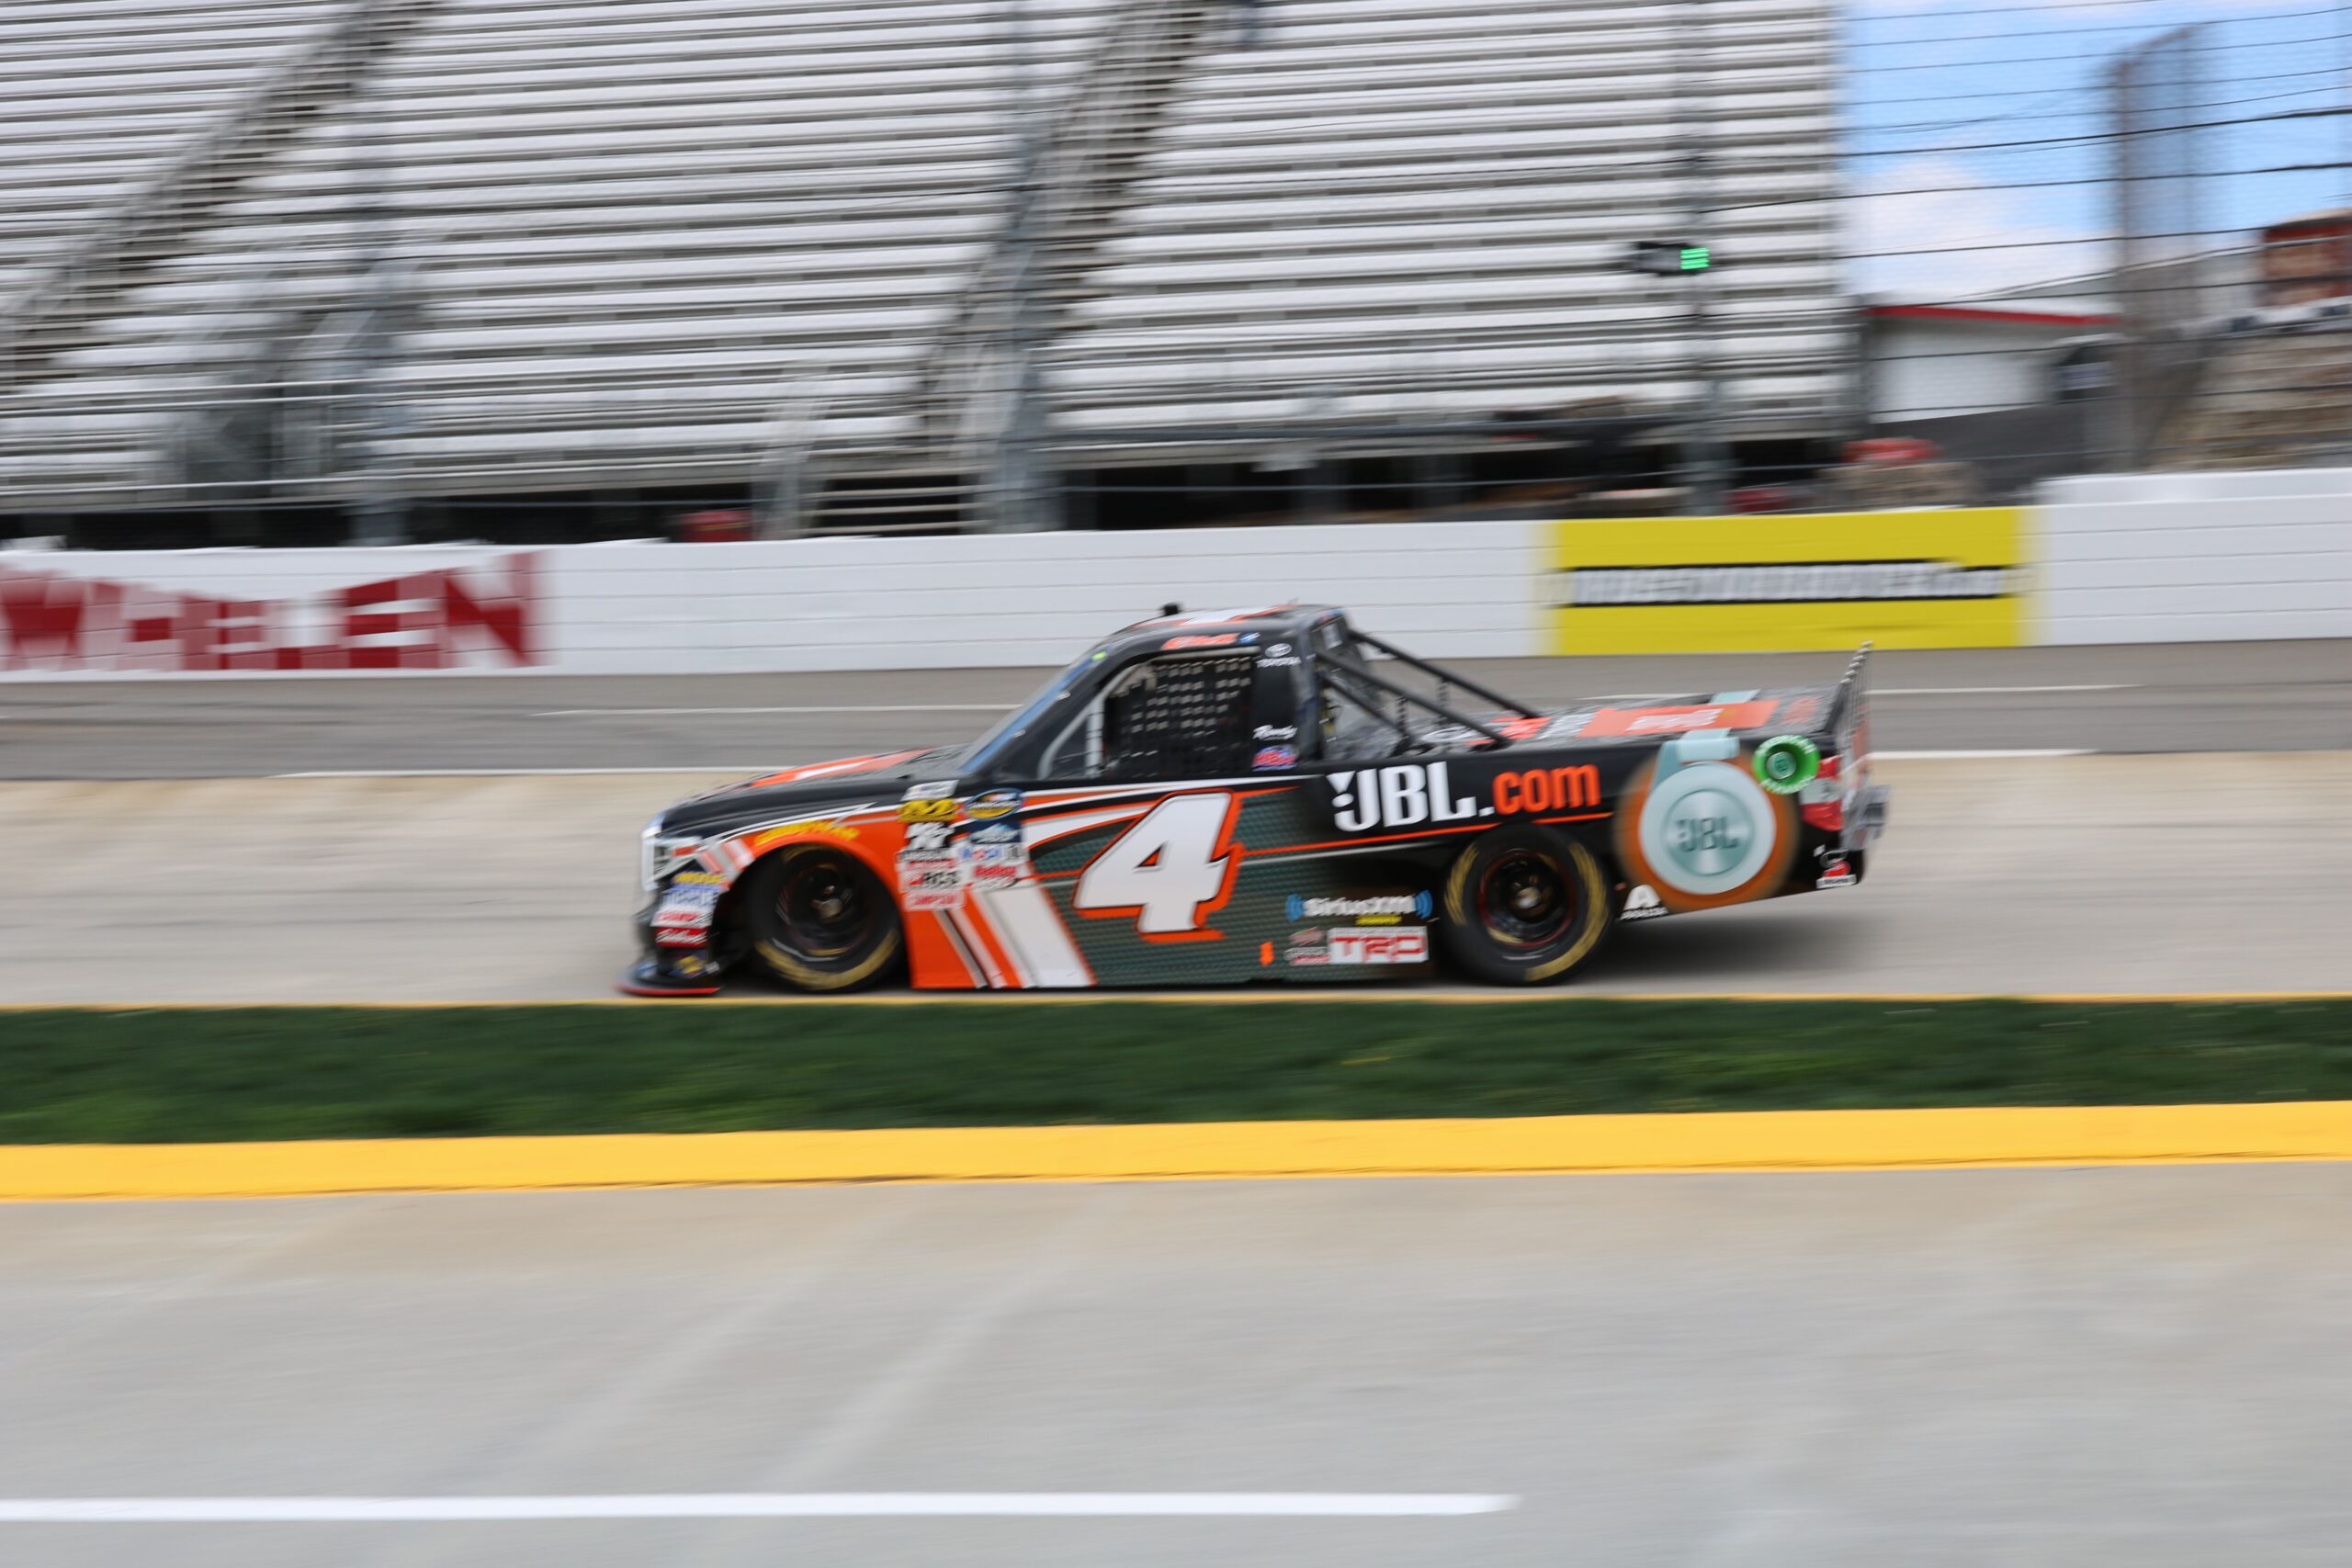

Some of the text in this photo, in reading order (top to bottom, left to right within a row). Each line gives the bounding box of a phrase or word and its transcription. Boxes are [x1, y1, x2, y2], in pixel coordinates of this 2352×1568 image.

[1327, 761, 1601, 832] JBL.com
[1674, 816, 1738, 852] JBL
[1073, 792, 1229, 933] 4
[1329, 935, 1427, 964] TRD
